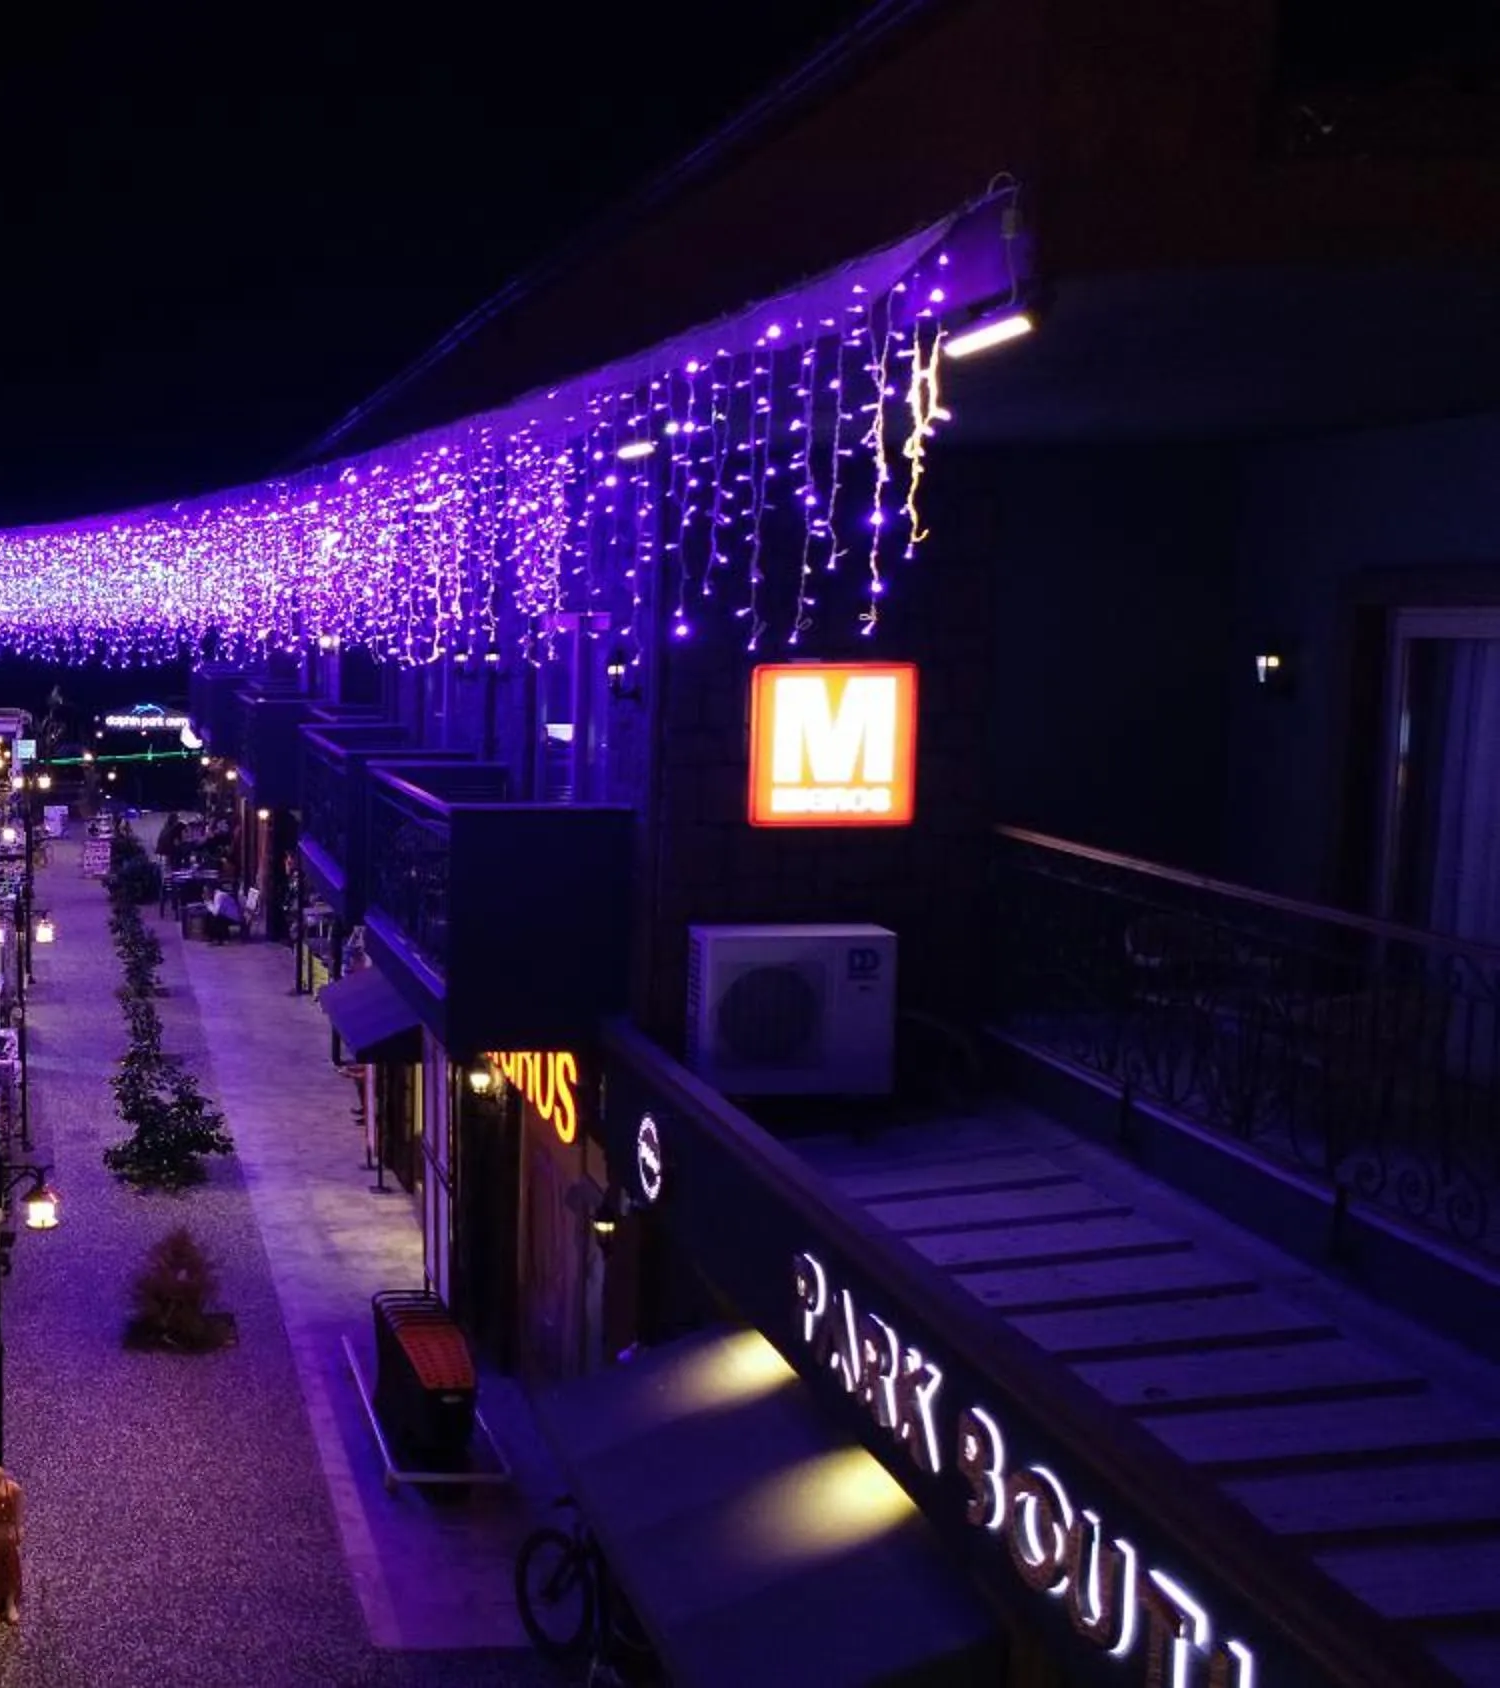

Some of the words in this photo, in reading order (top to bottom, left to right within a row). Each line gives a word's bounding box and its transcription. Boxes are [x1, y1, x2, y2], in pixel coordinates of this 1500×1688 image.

[105, 715, 141, 728] dolphin
[141, 716, 164, 729] park
[771, 676, 897, 783] M
[793, 1251, 945, 1475] PARK
